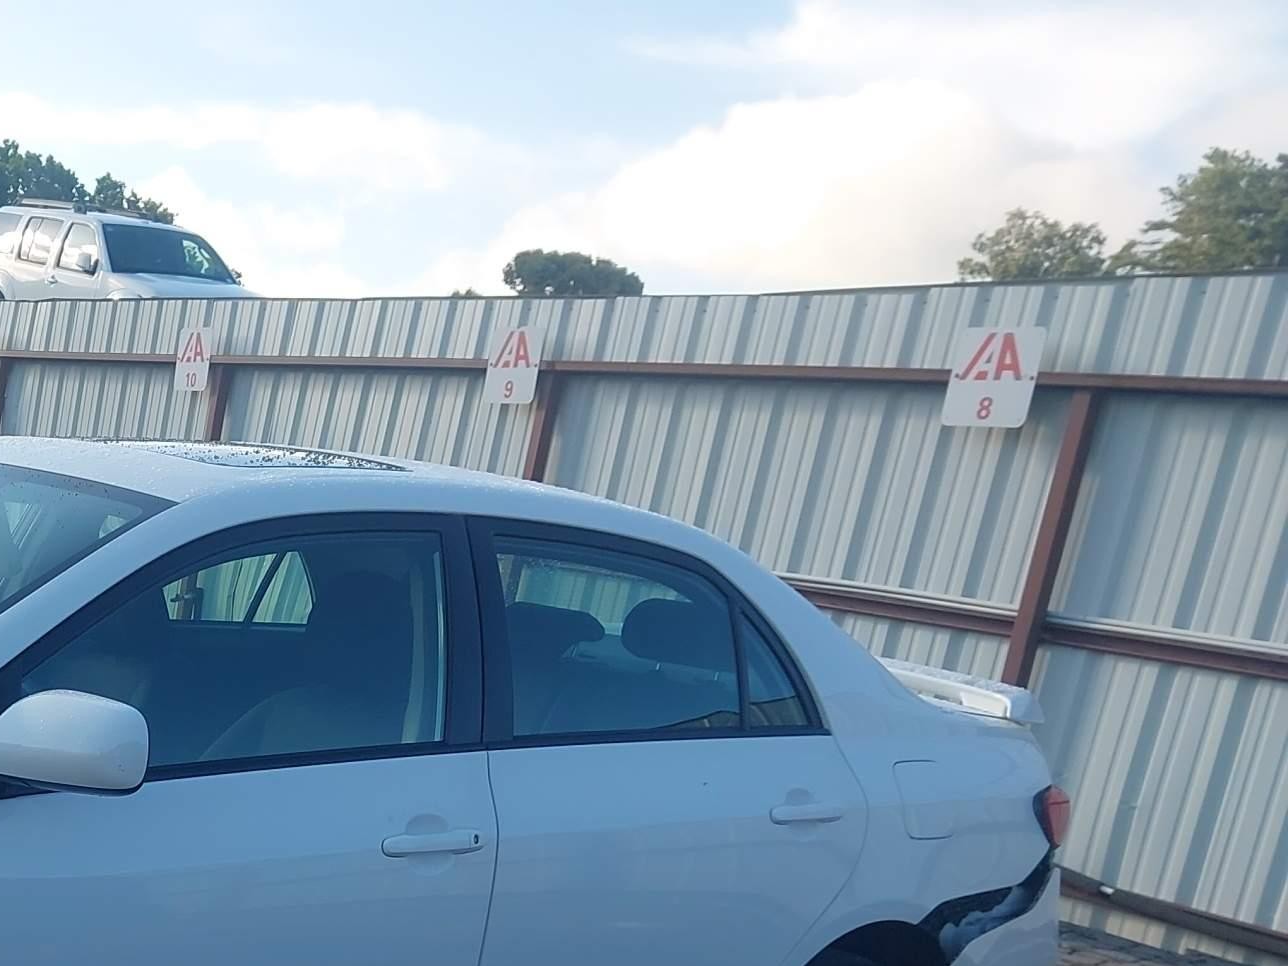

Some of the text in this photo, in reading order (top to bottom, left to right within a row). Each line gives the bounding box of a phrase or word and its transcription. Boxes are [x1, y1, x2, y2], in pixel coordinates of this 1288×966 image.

[186, 373, 197, 388] 10
[504, 380, 514, 399] 9
[977, 397, 993, 420] 8
